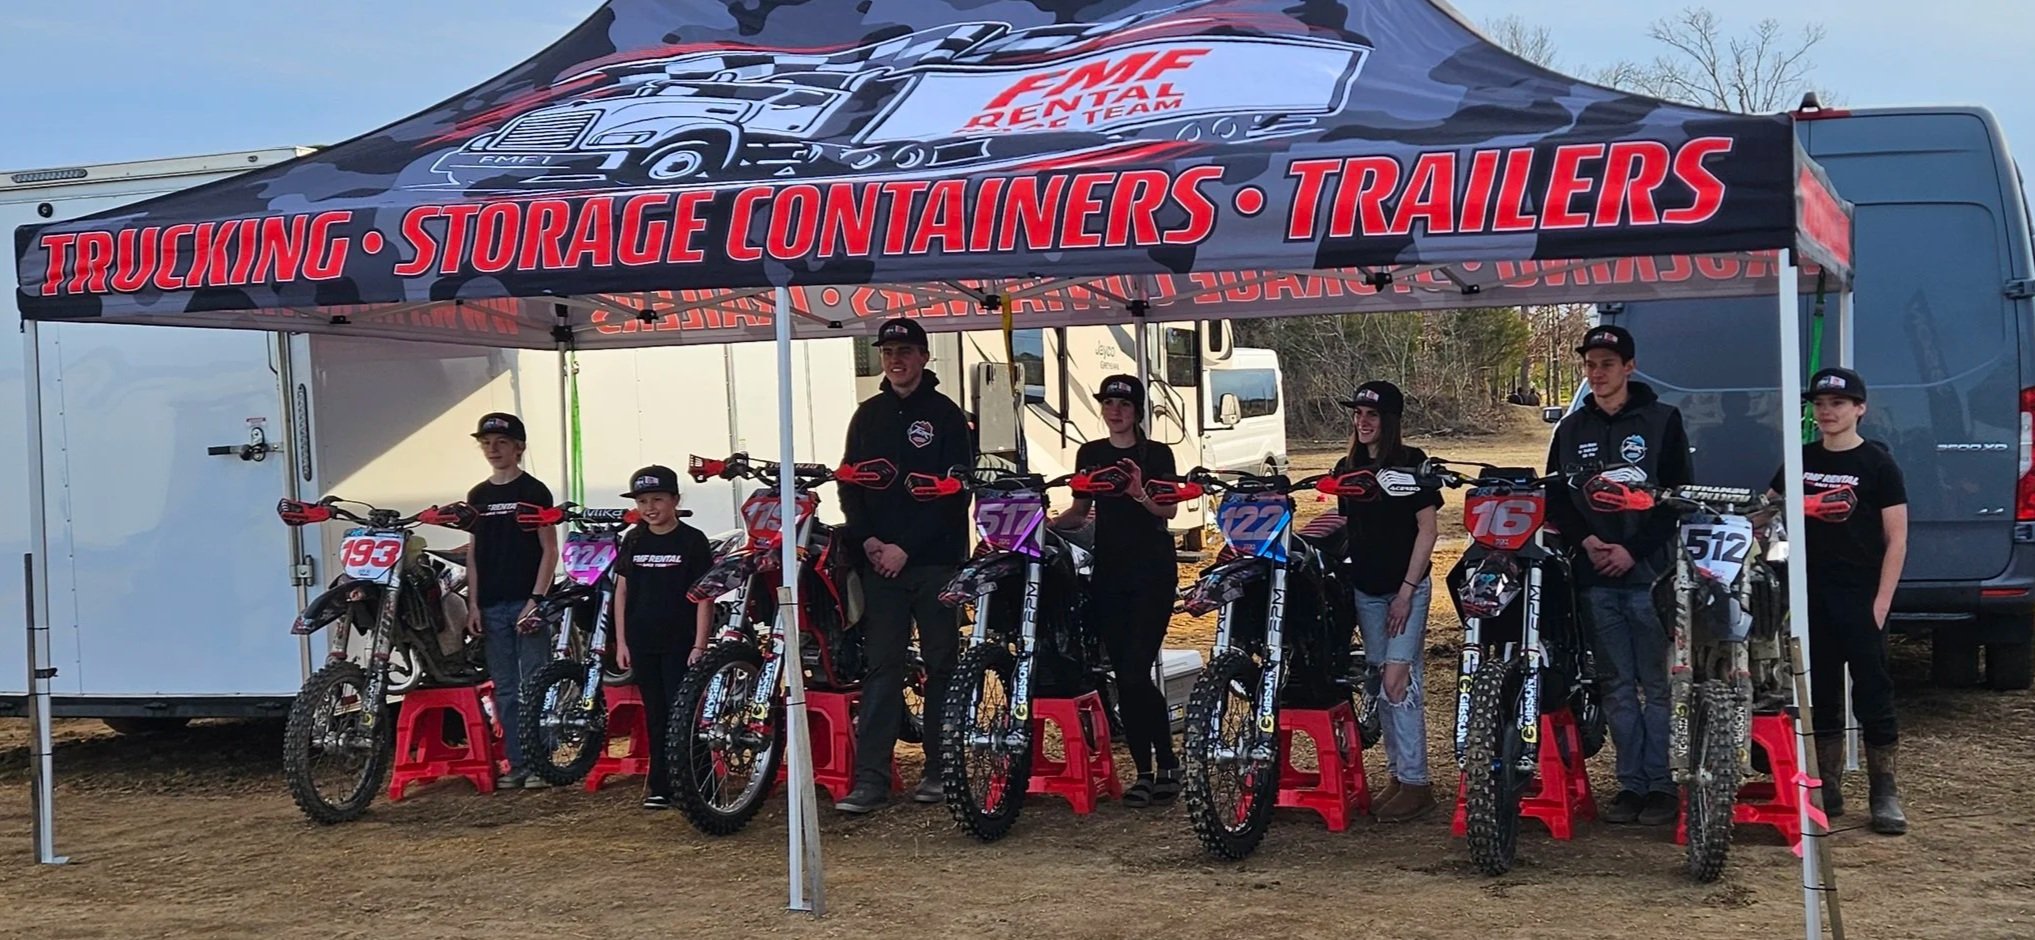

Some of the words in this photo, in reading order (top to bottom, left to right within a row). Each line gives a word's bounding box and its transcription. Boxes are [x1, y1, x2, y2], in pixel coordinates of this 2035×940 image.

[983, 48, 1213, 111] FMF
[964, 83, 1185, 128] RENTAL
[1083, 98, 1182, 126] TEAM
[41, 211, 352, 297] TRUCKING
[394, 195, 708, 277] STORAGE
[725, 165, 1225, 261] CONTAINERS
[1288, 137, 1734, 239] TRAILERS
[977, 503, 1041, 535] 517
[1221, 505, 1284, 541] 122
[1472, 499, 1537, 537] 16
[341, 539, 402, 568] 193
[648, 554, 682, 564] RENTAL
[1686, 529, 1747, 564] 512
[702, 673, 723, 718] GIBSON
[1018, 660, 1029, 704] GIBSON
[1263, 669, 1277, 716] GIBSON
[1457, 693, 1471, 743] GIBSON
